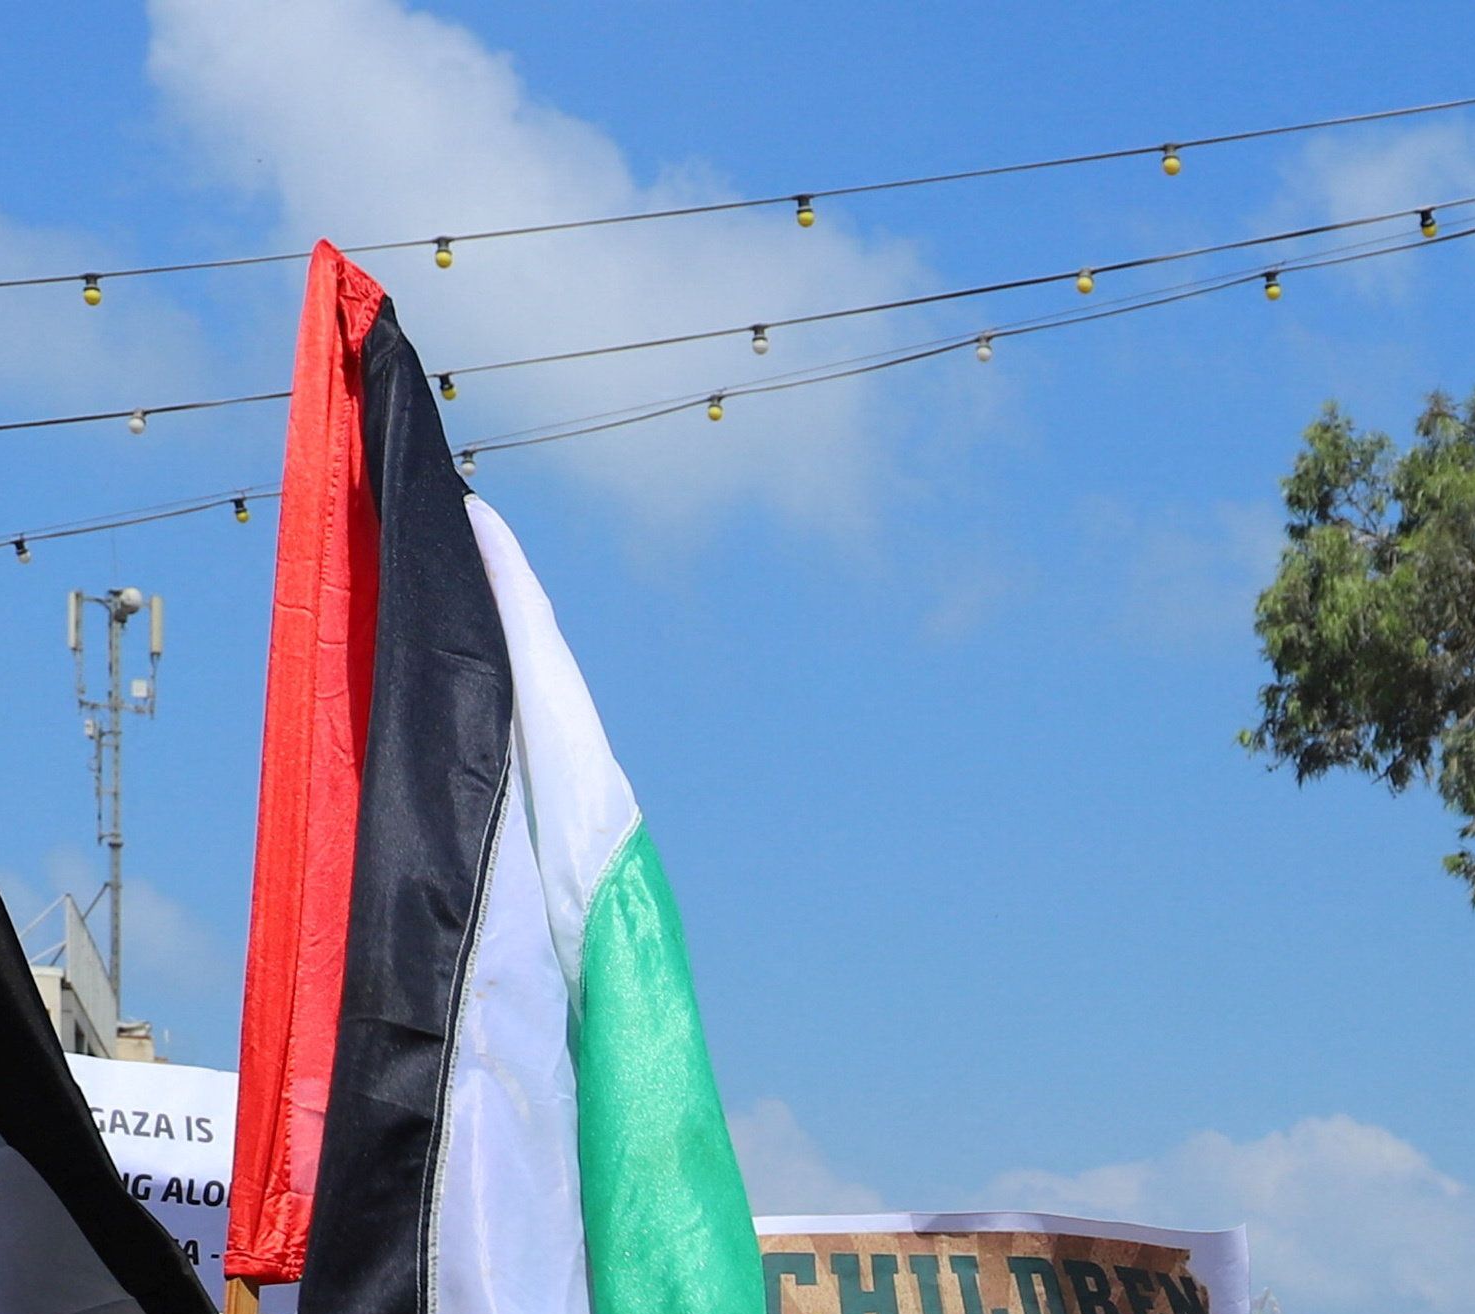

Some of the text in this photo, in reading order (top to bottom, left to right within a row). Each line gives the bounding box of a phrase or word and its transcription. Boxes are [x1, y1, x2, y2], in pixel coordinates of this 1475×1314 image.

[90, 1107, 214, 1143] GAZA IS
[161, 1177, 231, 1208] ALO
